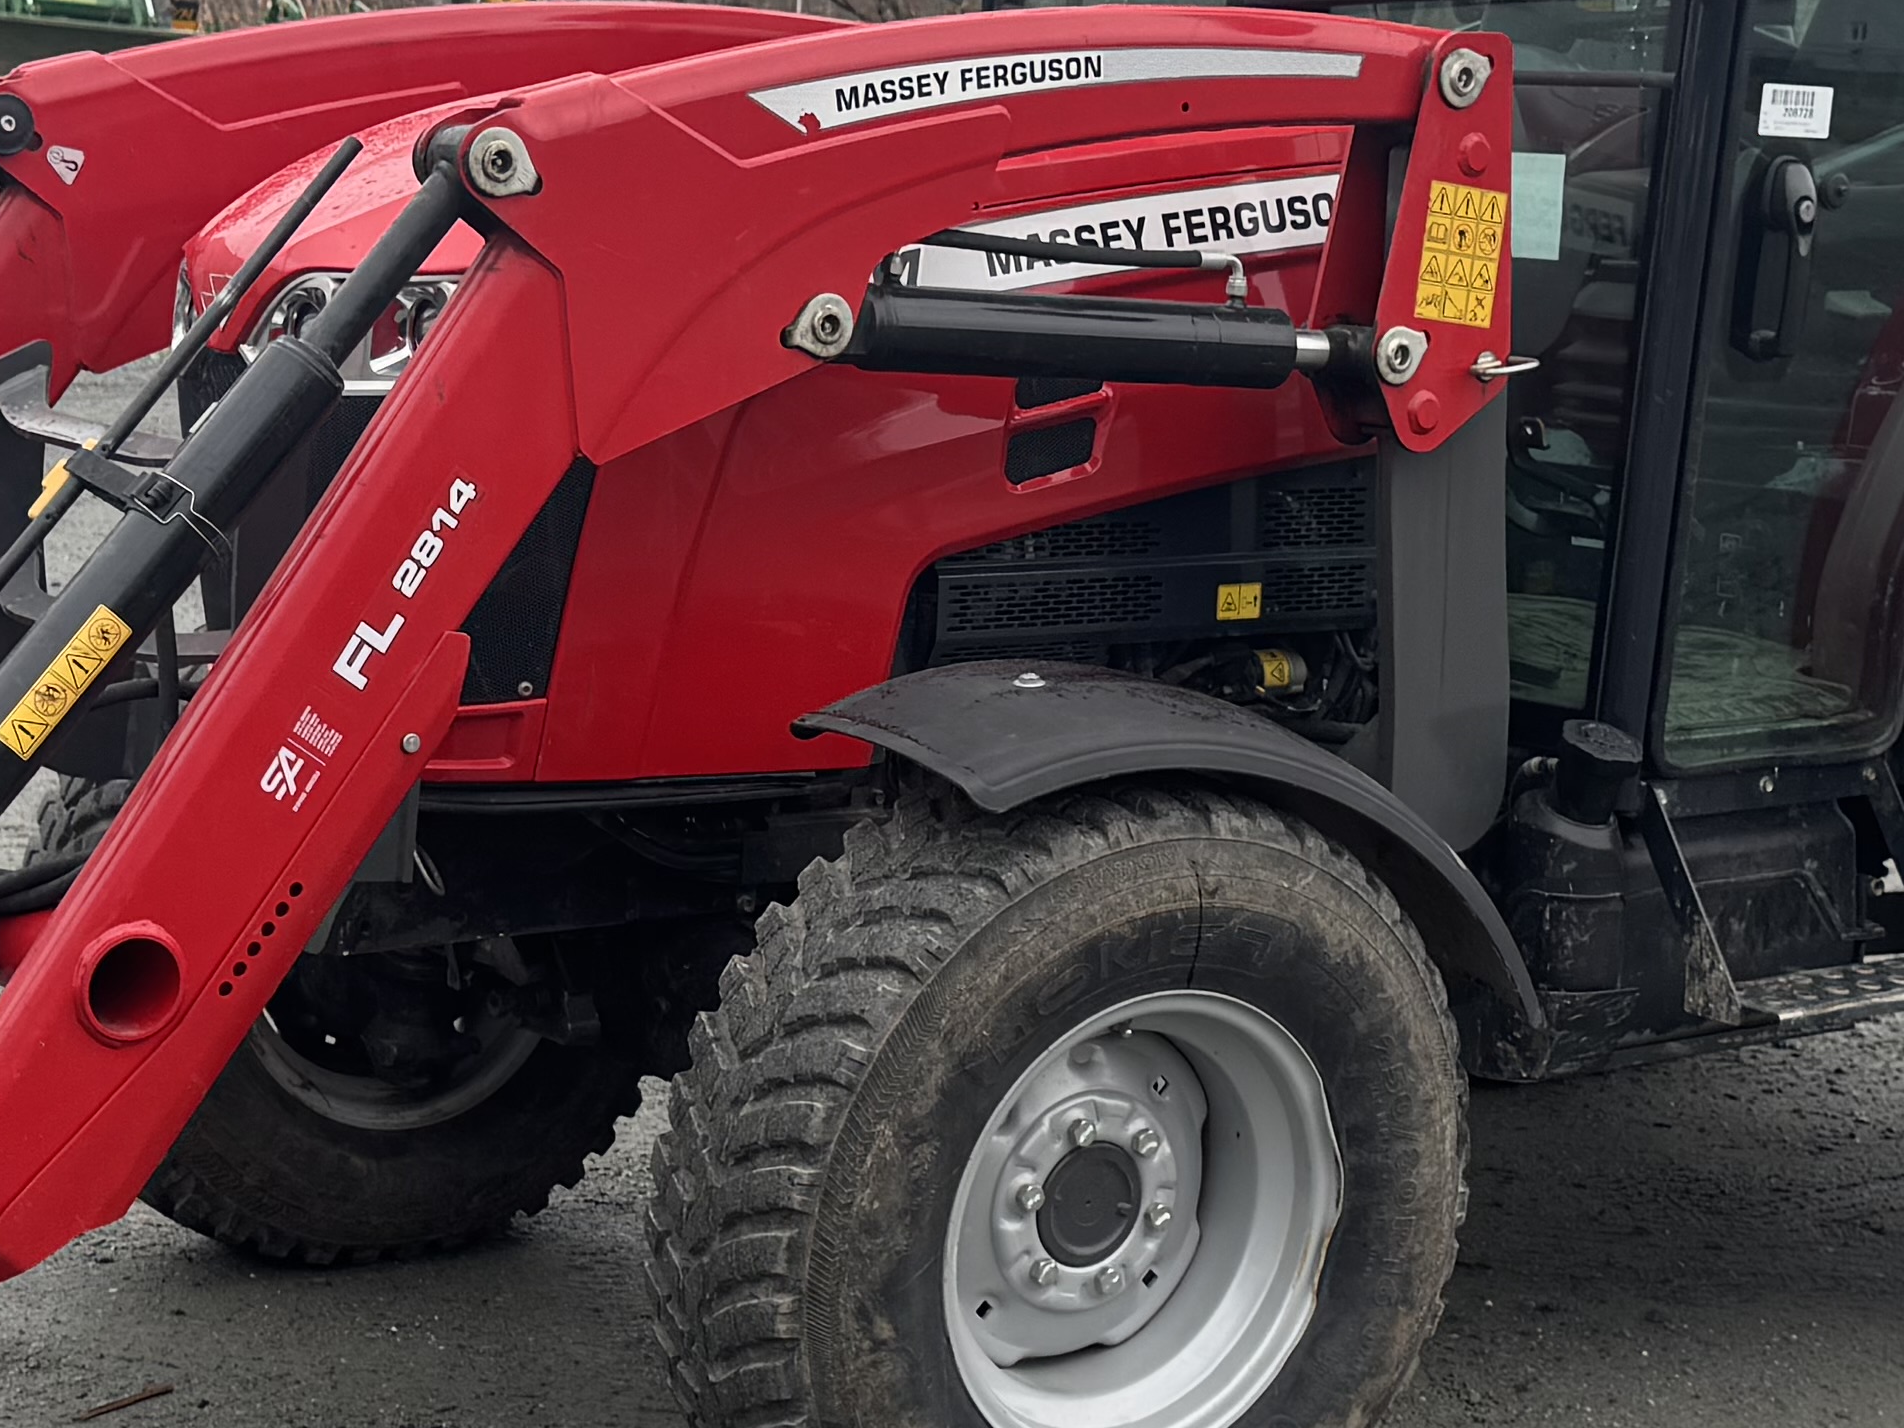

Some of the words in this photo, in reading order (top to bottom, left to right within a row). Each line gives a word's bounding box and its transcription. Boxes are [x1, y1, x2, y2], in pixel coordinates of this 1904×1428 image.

[835, 71, 949, 112] MASSEY
[960, 55, 1102, 92] FERGUSON
[985, 216, 1146, 277] MASSEY
[332, 613, 406, 691] FL
[391, 477, 477, 599] 2814
